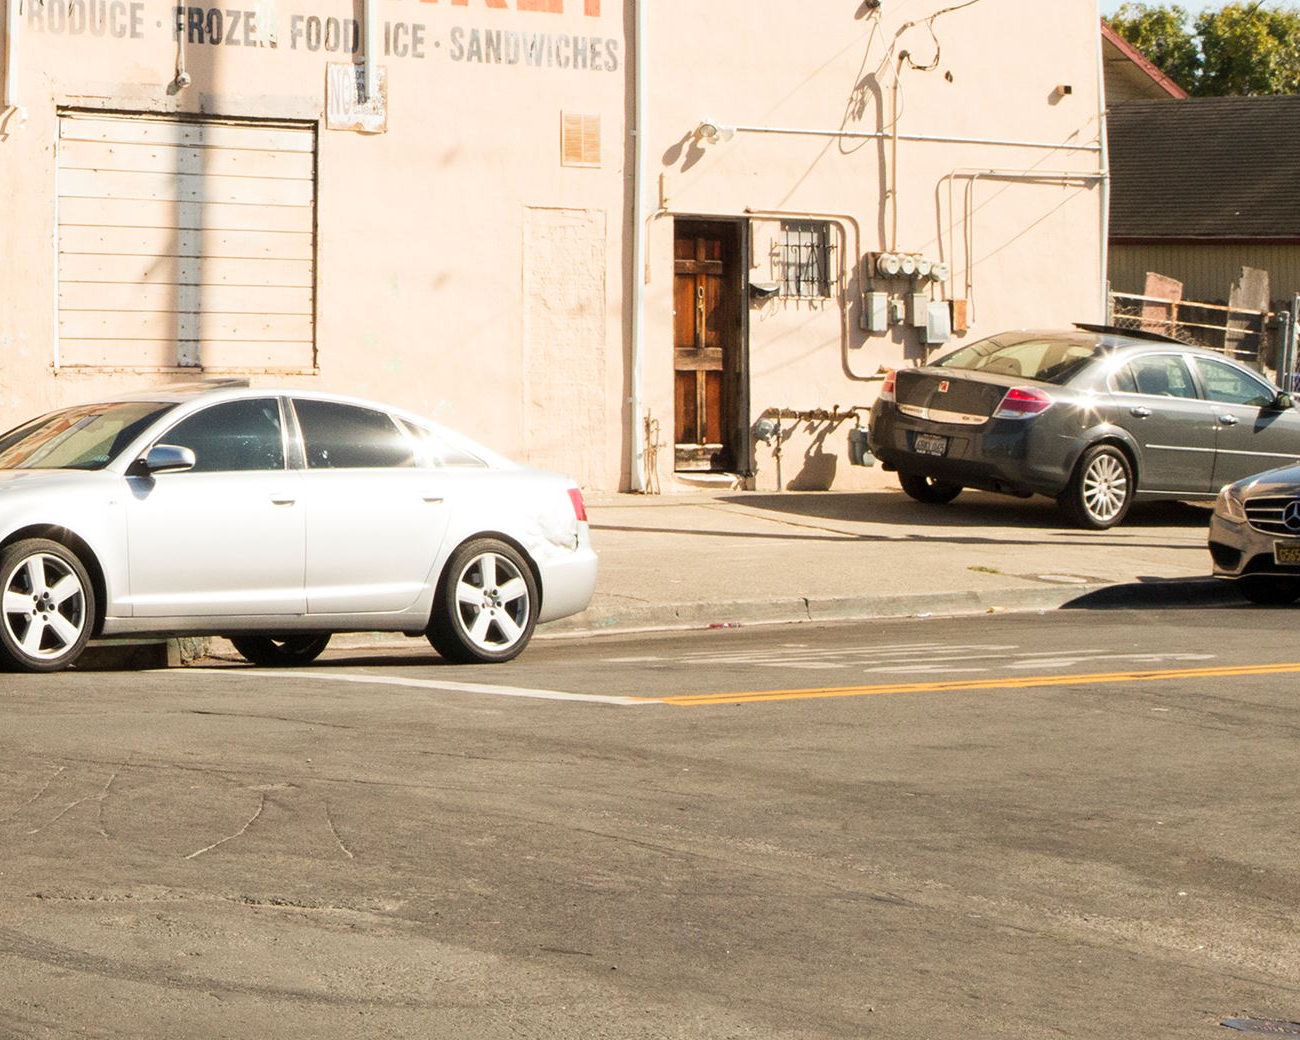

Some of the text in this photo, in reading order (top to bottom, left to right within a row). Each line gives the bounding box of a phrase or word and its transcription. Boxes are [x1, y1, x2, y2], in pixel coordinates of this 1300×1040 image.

[172, 6, 278, 49] FROZE
[290, 14, 360, 54] FOOD
[384, 21, 426, 59] ICE
[449, 26, 619, 73] SANDWICHES
